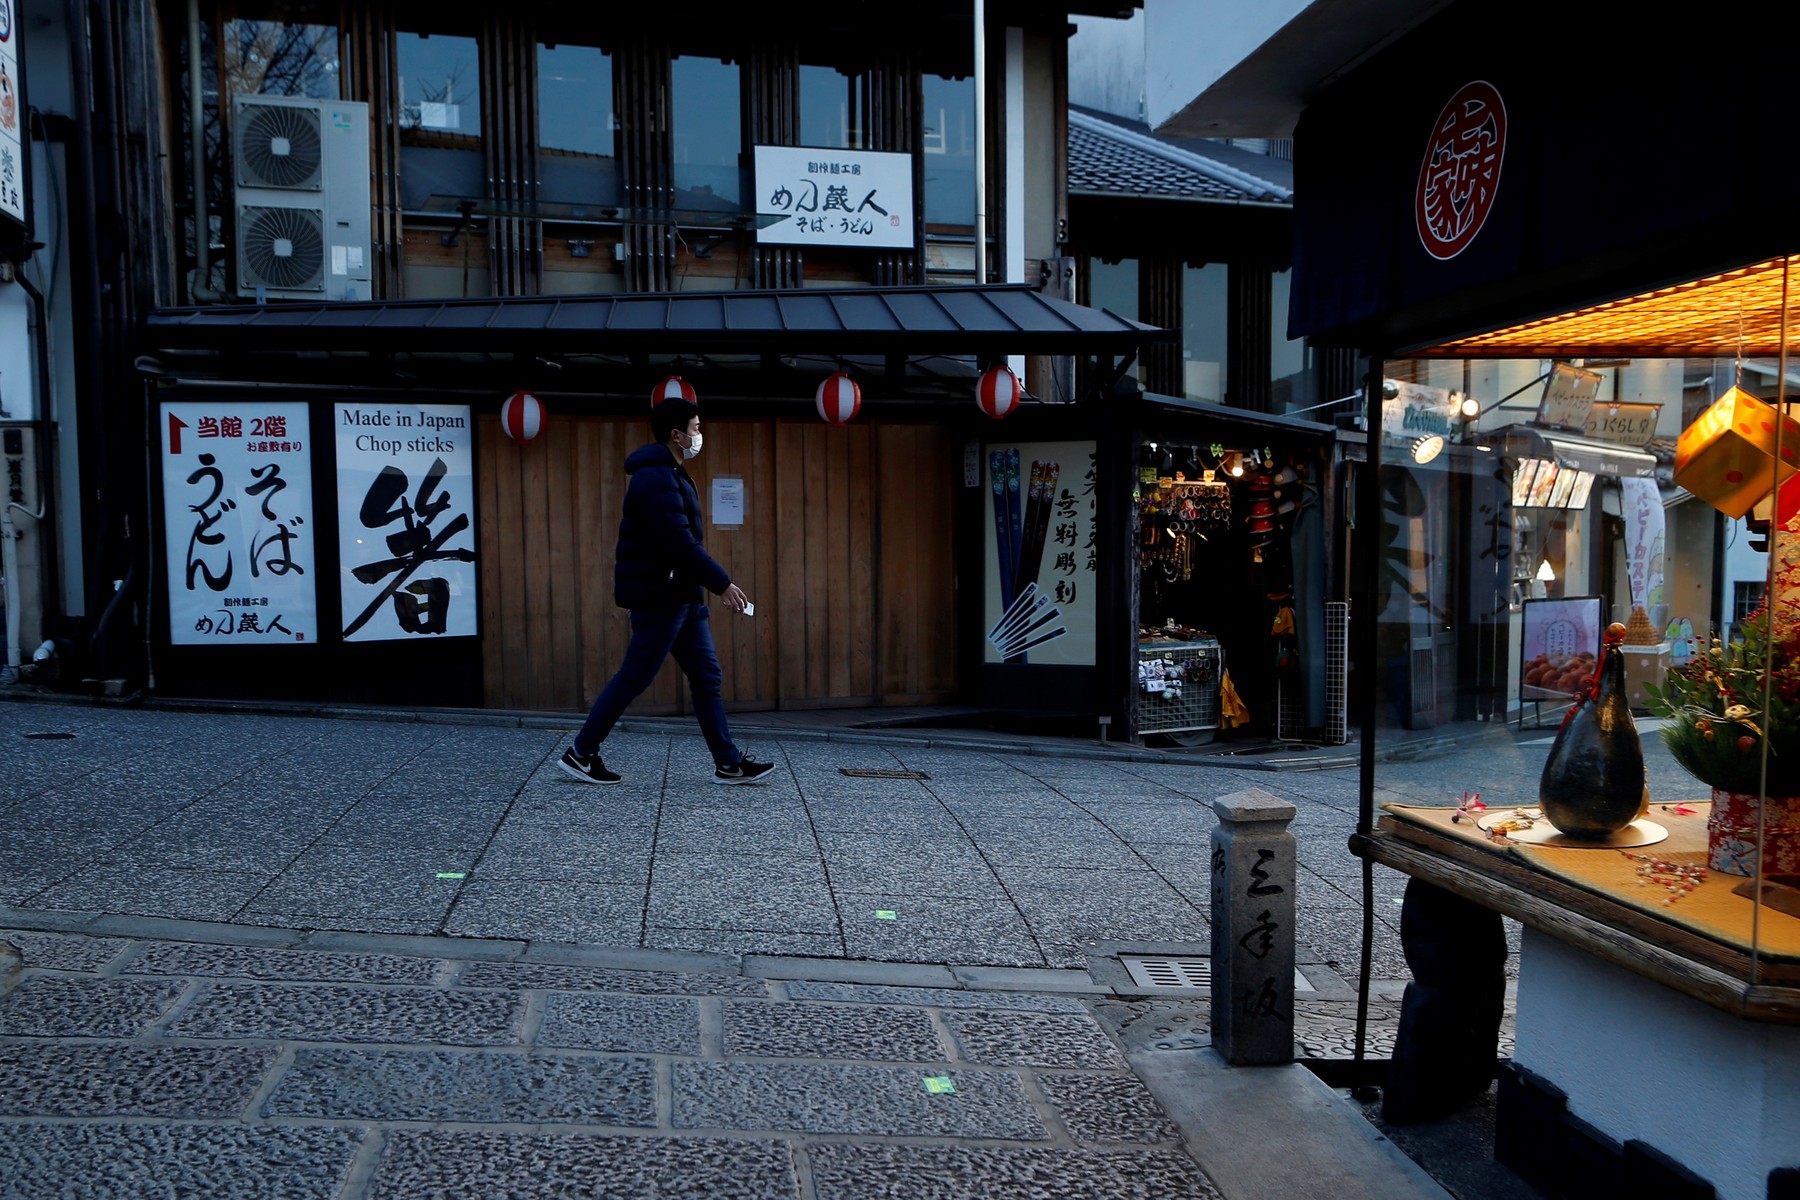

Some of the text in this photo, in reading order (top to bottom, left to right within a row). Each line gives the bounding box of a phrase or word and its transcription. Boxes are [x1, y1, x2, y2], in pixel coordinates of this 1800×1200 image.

[808, 161, 862, 176] 創作麺工房
[770, 178, 889, 217] めん蔵人
[796, 216, 873, 235] そば・うどん
[197, 415, 287, 439] 当館 2階
[343, 409, 466, 432] Made in Japan
[246, 441, 303, 453] お座敷有り
[356, 435, 455, 457] Chop sticks
[186, 453, 237, 592] うどん
[245, 463, 305, 578] そば
[343, 457, 476, 639] 箸
[1054, 488, 1080, 605] 無料彫刻
[194, 609, 292, 636] めん蔵人
[1240, 849, 1288, 1023] 三年坂
